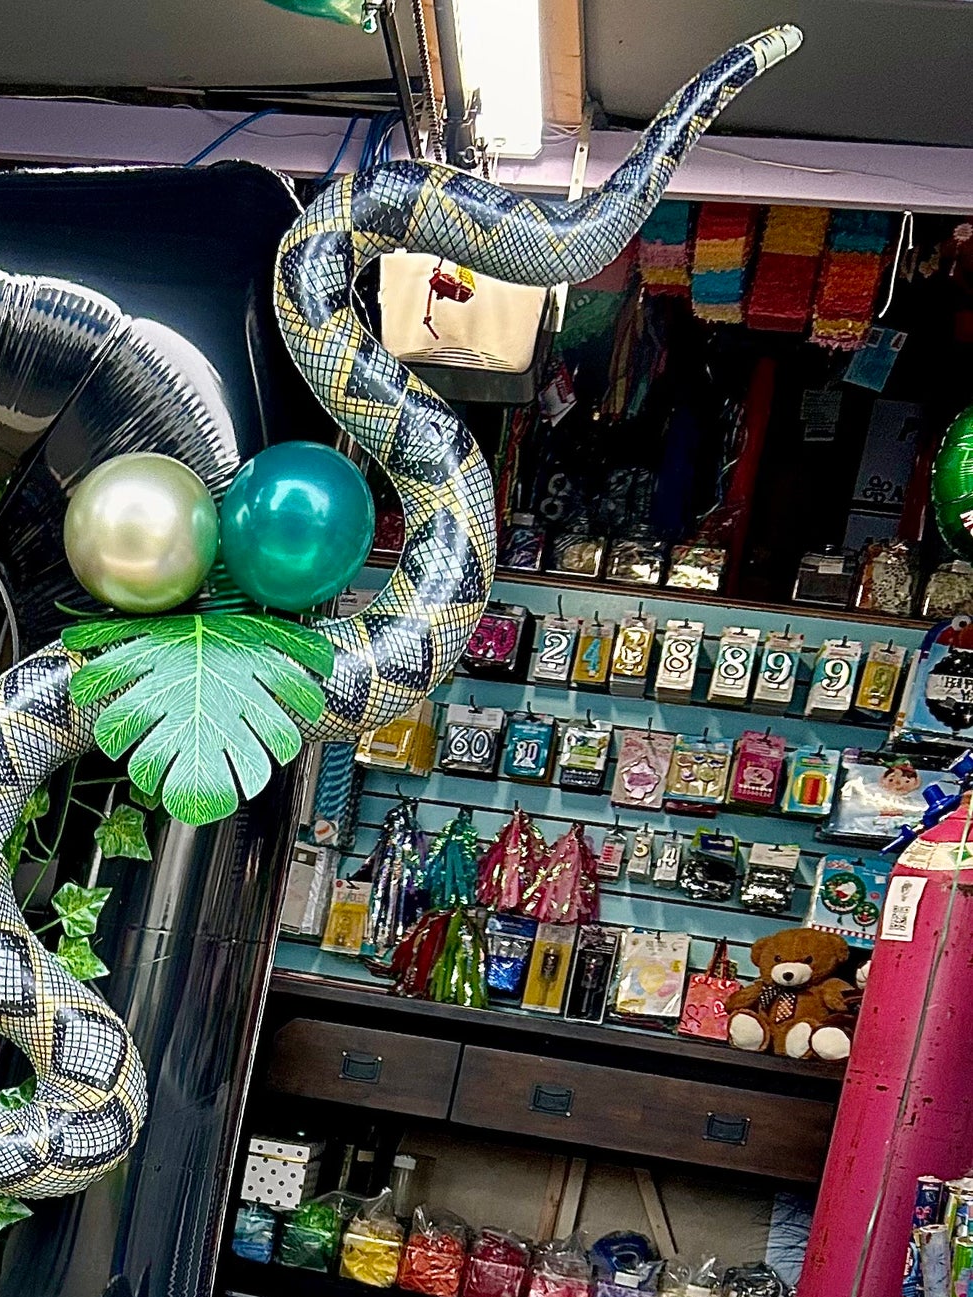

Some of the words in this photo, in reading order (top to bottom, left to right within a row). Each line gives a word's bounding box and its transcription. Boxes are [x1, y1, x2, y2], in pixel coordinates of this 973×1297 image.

[541, 633, 570, 665] 2
[582, 638, 602, 672] 4
[663, 639, 693, 673] 8
[718, 646, 748, 680] 8
[762, 651, 792, 684] 9
[821, 659, 850, 692] 9
[449, 728, 491, 758] 60
[633, 837, 649, 858] 3
[663, 848, 677, 867] 4
